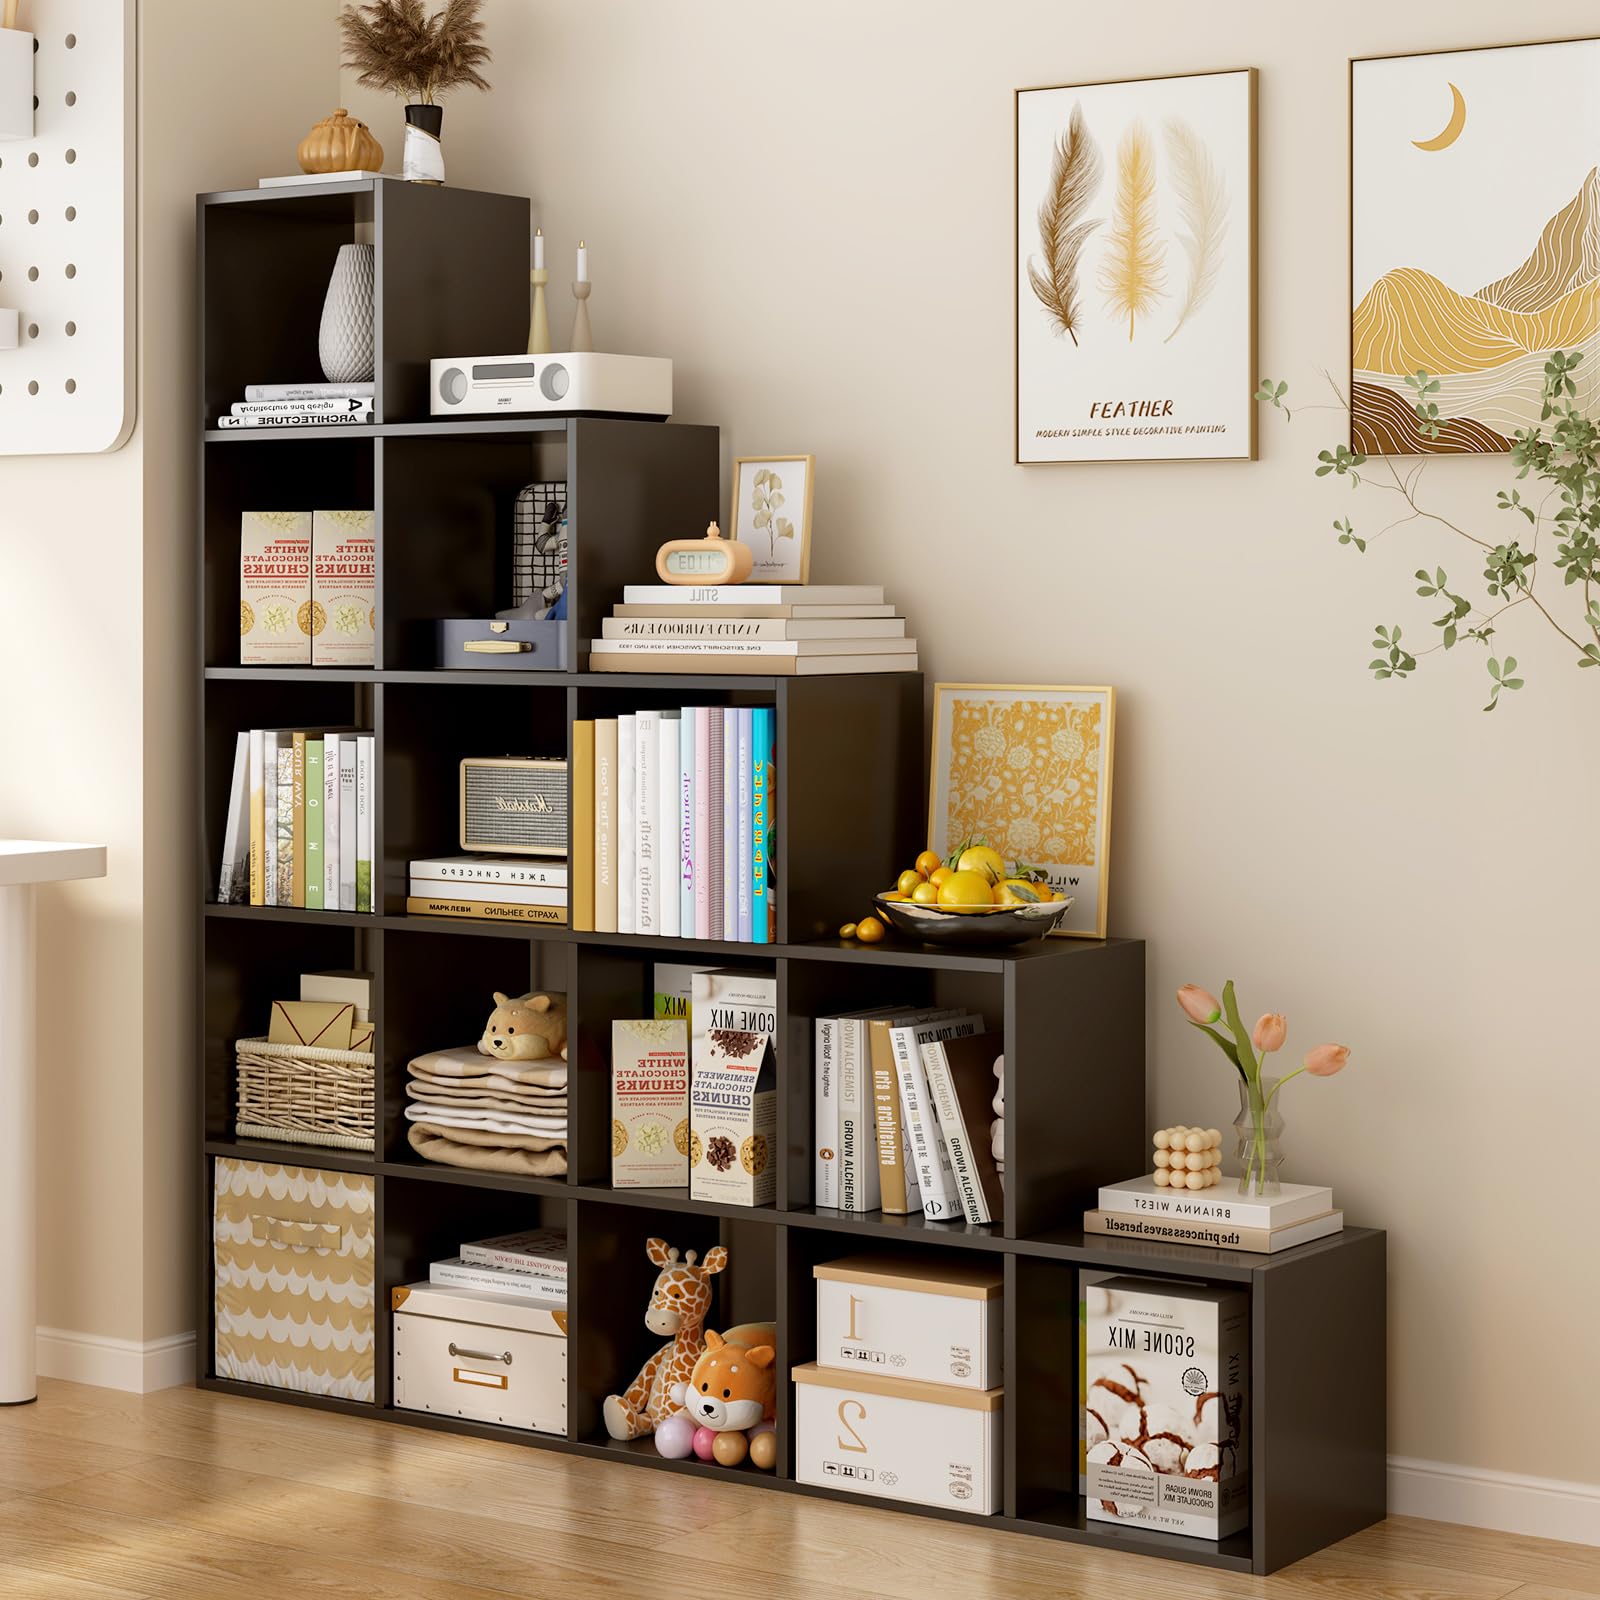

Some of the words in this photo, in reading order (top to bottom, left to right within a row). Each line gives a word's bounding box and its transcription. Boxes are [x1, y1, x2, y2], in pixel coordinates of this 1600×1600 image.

[1090, 400, 1173, 419] FEATHER
[1036, 430, 1069, 438] MODERN
[1072, 429, 1102, 437] SIMPLE
[1105, 428, 1130, 436] STYLE
[1133, 426, 1182, 436] DECORATIVE
[1185, 425, 1226, 434] PAINTING
[484, 907, 524, 917] СИЛЬНЕЕ
[527, 910, 559, 919] СТРАХА
[822, 1023, 831, 1043] Virginia
[844, 1020, 854, 1050] ROWN
[917, 1031, 934, 1044] IT'S
[823, 1044, 831, 1060] Woolf
[899, 1051, 908, 1060] HOW
[844, 1051, 855, 1104] ALCHEMIST
[875, 1070, 892, 1089] arts
[904, 1073, 912, 1081] YOU
[927, 1044, 940, 1071] ROWN
[934, 1072, 954, 1121] ALCHEMIST
[822, 1074, 830, 1097] Lighthouse
[909, 1101, 918, 1110] HOW
[913, 1123, 922, 1132] YOU
[844, 1120, 853, 1157] GROWN
[877, 1106, 896, 1165] architecture
[915, 1133, 925, 1144] WANT
[921, 1165, 930, 1174] Paul
[844, 1160, 854, 1210] ALCHEMIS
[923, 1176, 932, 1188] Arden
[950, 1138, 966, 1173] GROWN
[960, 1175, 981, 1222] ALCHEMIS
[494, 1255, 513, 1264] GRAIN
[527, 1260, 550, 1270] AGAINST
[553, 1265, 568, 1274] OING
